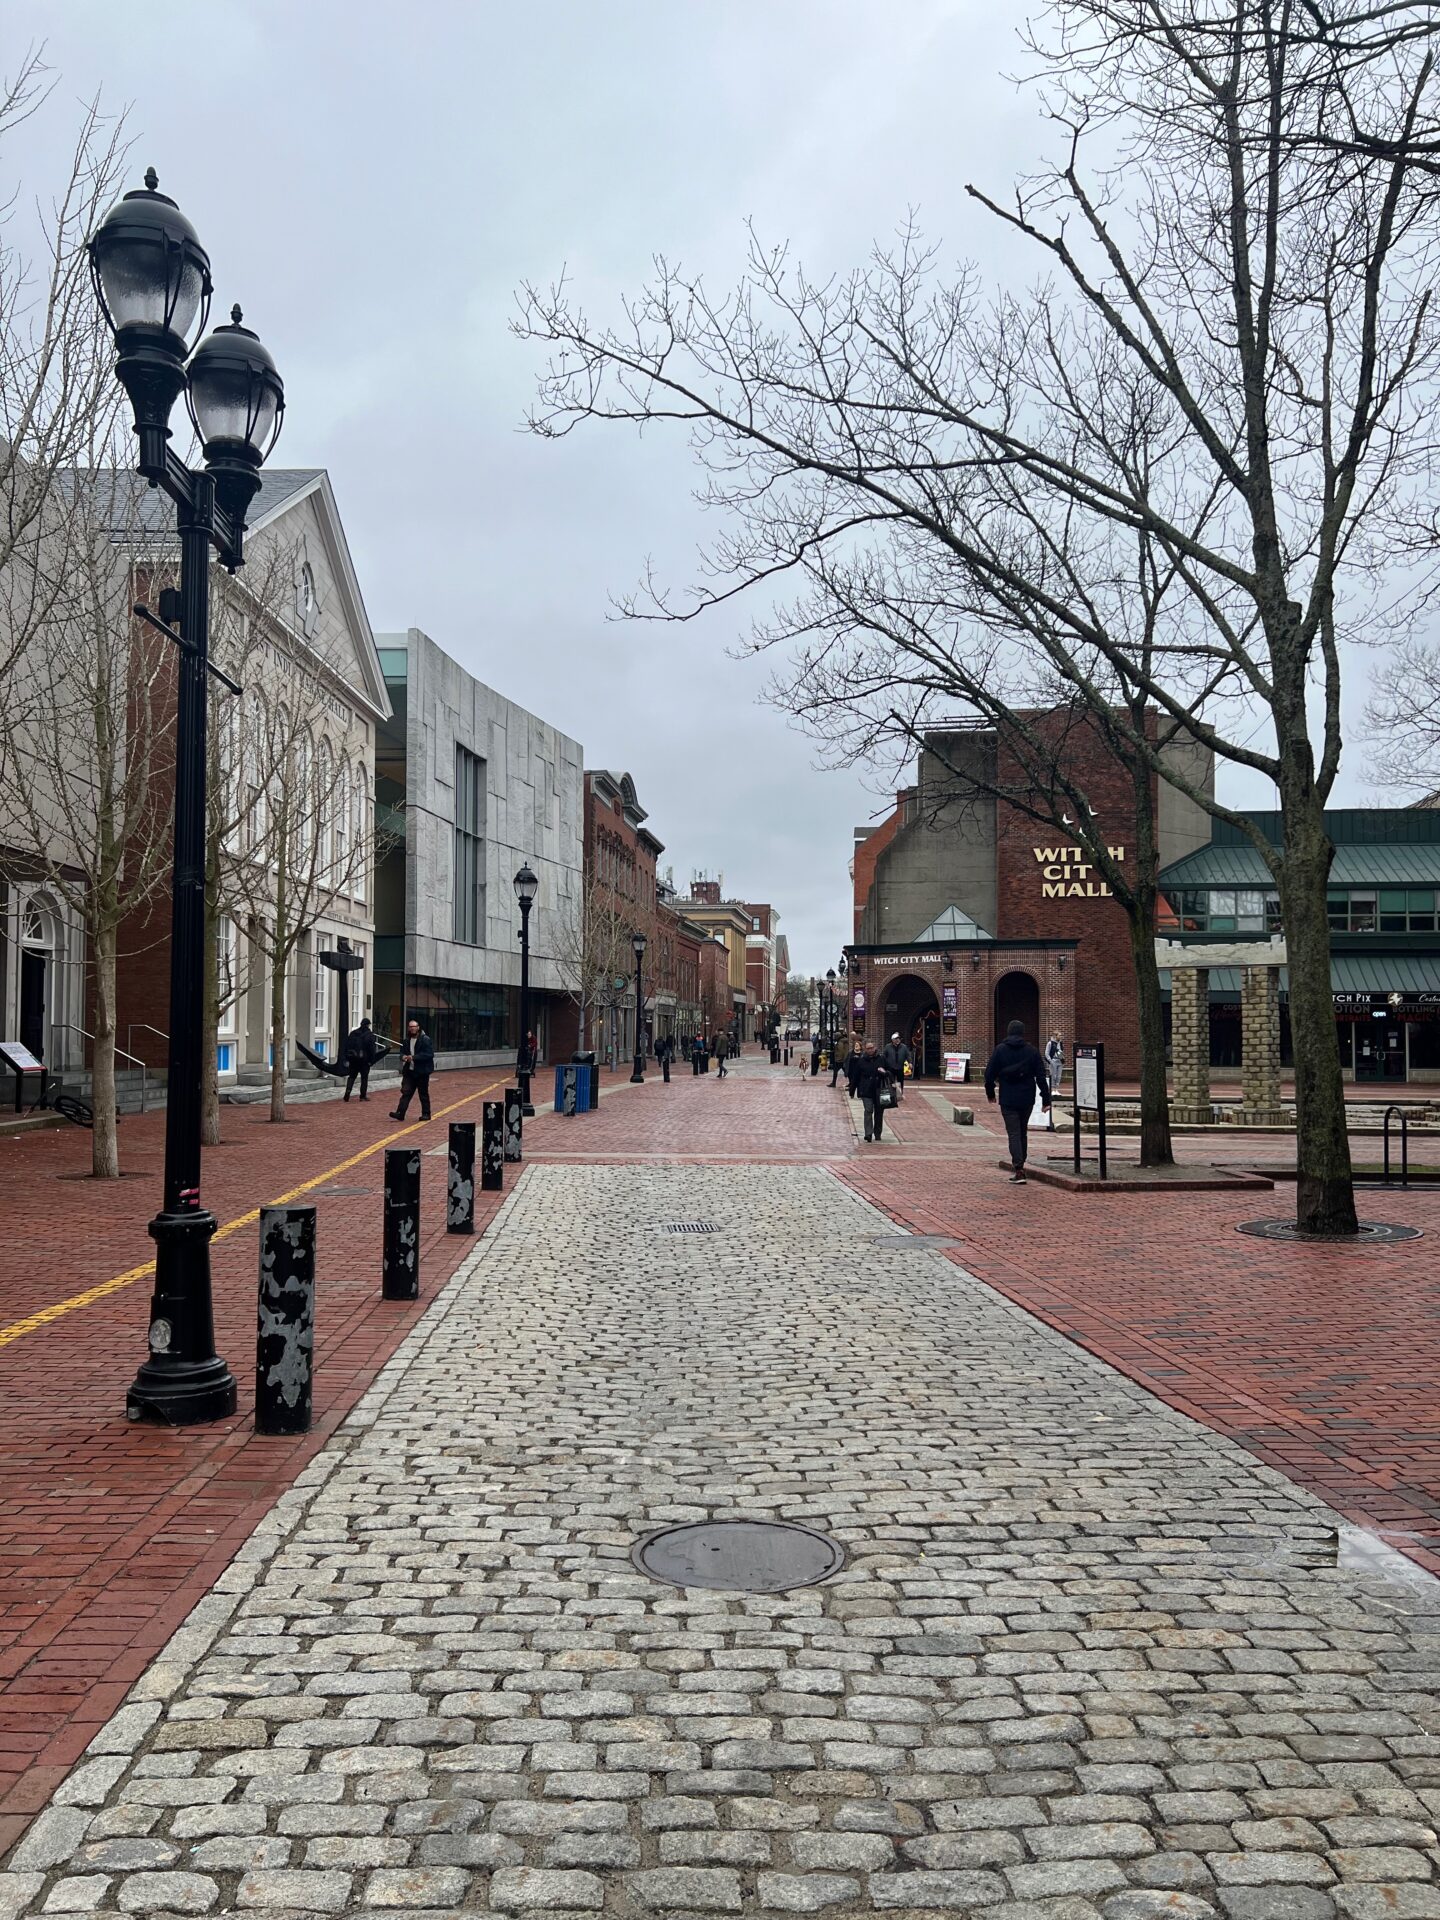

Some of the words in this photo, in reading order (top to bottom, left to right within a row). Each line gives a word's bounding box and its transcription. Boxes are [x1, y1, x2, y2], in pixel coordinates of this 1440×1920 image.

[1033, 847, 1125, 862] WITH
[1043, 865, 1094, 880] CIT
[1042, 882, 1114, 899] MALL
[874, 956, 898, 965] WITCH
[900, 955, 920, 964] CITY
[921, 954, 942, 963] MALL
[1332, 994, 1352, 1003] TCH
[1334, 1004, 1371, 1014] OTION
